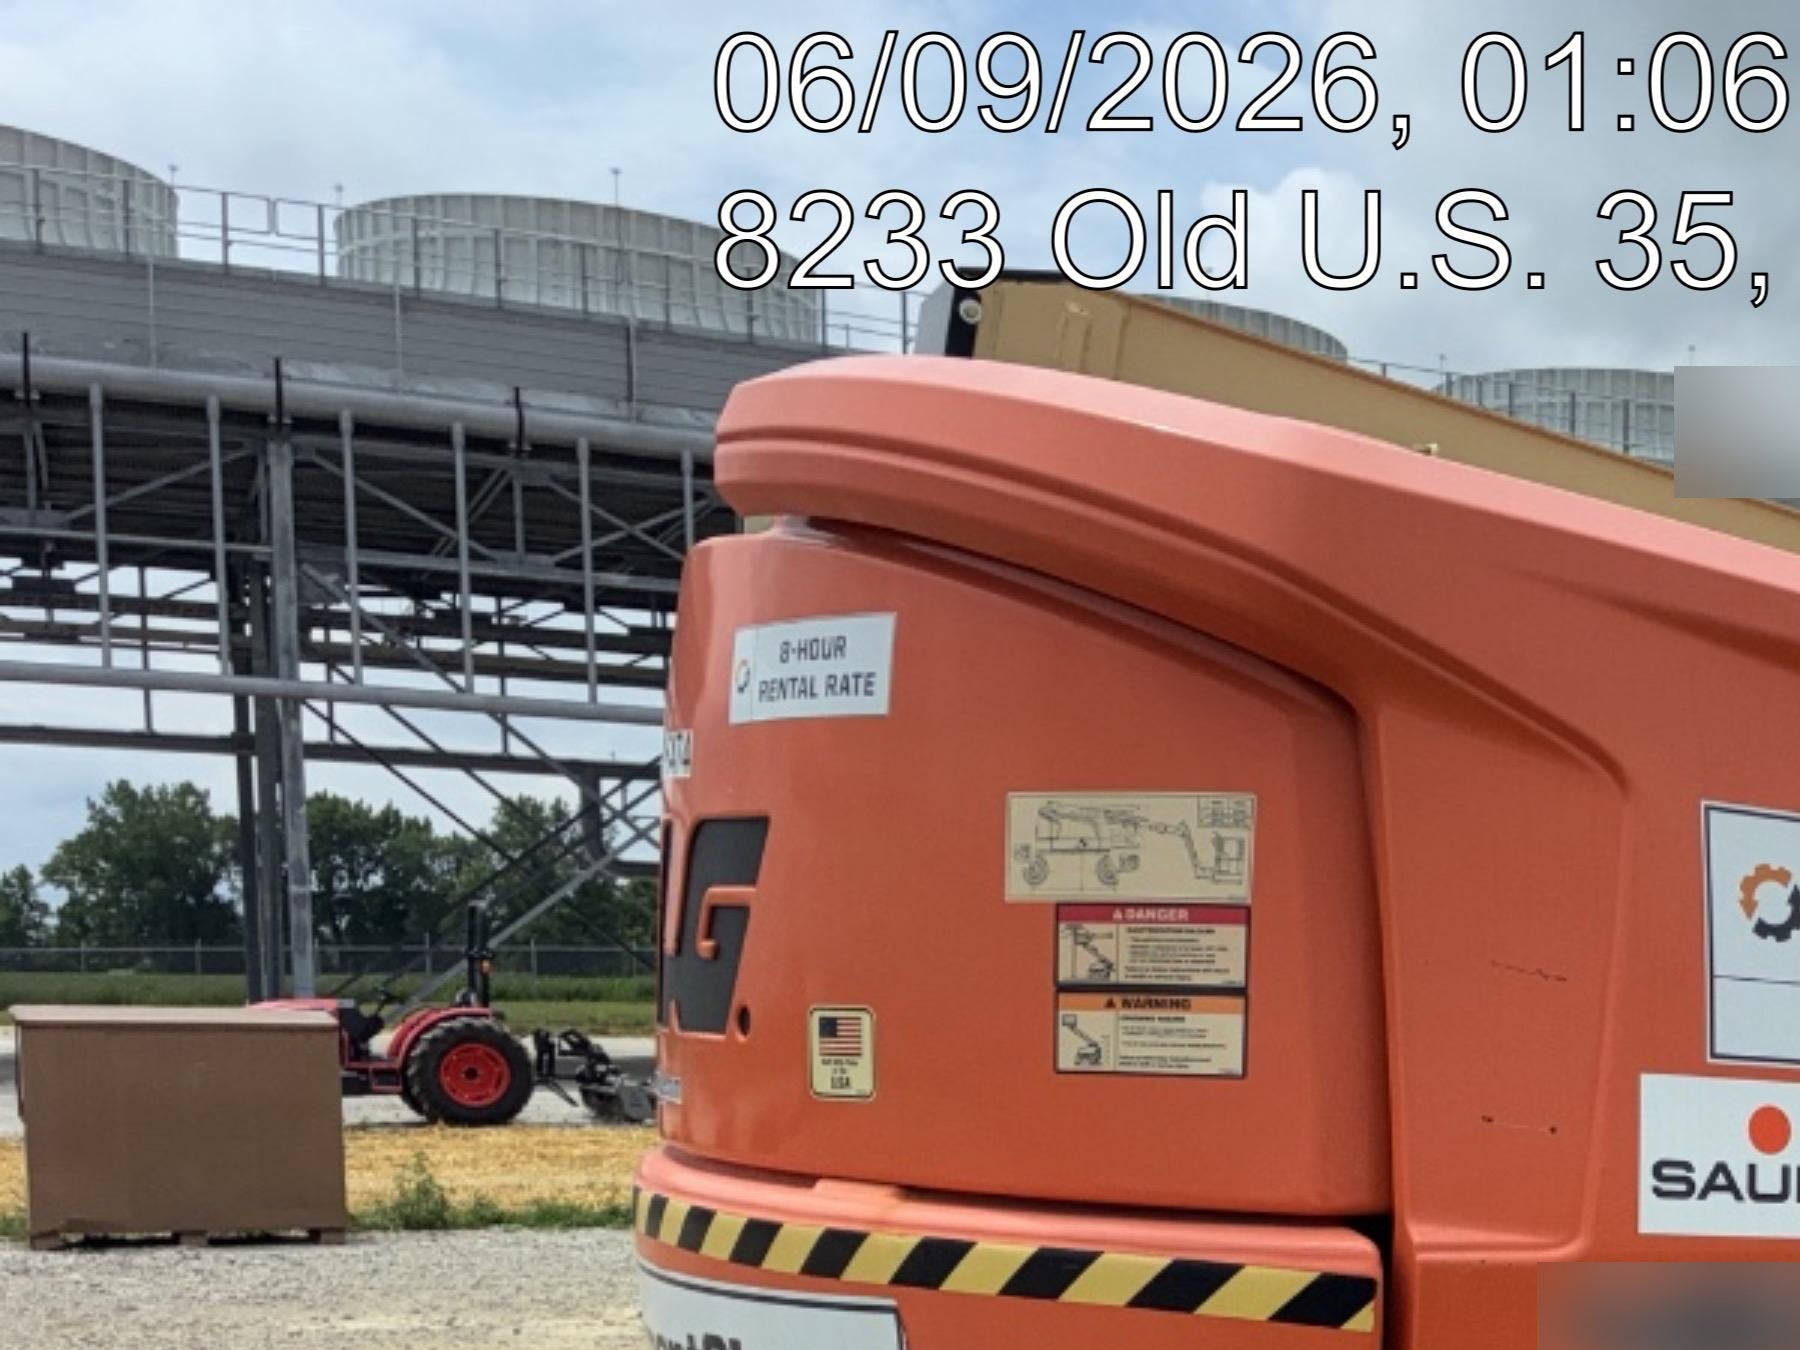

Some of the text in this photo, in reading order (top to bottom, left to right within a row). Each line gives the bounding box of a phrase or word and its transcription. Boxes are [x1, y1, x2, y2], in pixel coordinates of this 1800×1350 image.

[778, 635, 847, 664] 8-HOUR
[758, 671, 877, 704] RENTAL RATE
